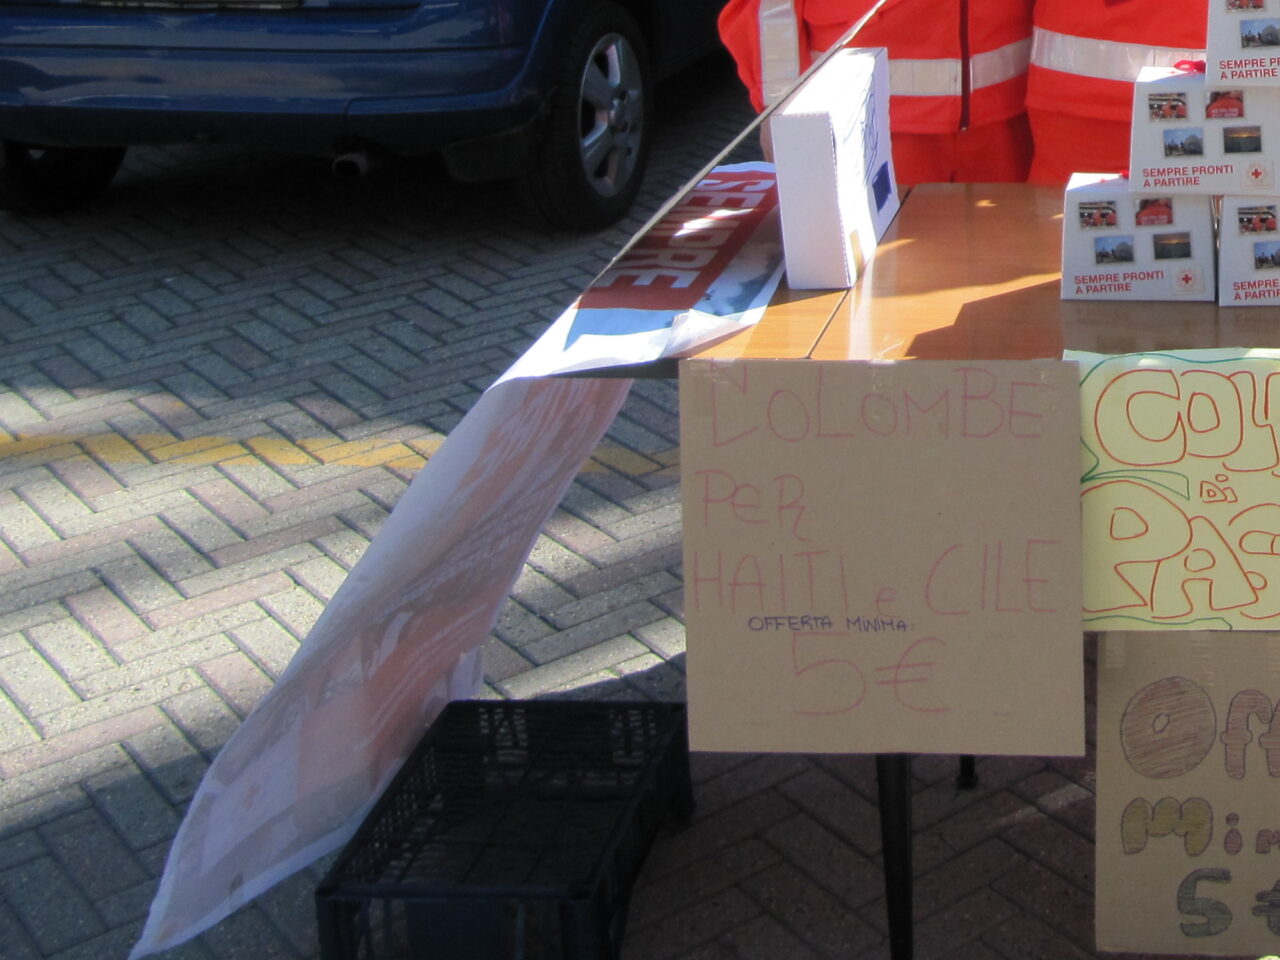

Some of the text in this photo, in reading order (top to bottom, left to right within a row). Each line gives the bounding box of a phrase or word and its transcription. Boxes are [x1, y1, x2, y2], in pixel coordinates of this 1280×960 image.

[1219, 58, 1266, 70] SEMPRE
[1220, 68, 1278, 81] A PARTIRE
[1142, 164, 1234, 178] SEMPRE PRONTI
[1143, 176, 1200, 188] A PARTIRE
[592, 179, 776, 288] SEMPRE
[1074, 270, 1164, 285] SEMPRE PRONTI
[1075, 283, 1132, 295] A PARTIRE
[1233, 279, 1280, 291] SEMPRE
[1234, 292, 1241, 301] A
[693, 549, 849, 615] HAITI
[924, 539, 1062, 616] CILE
[748, 614, 833, 631] OFFERTA
